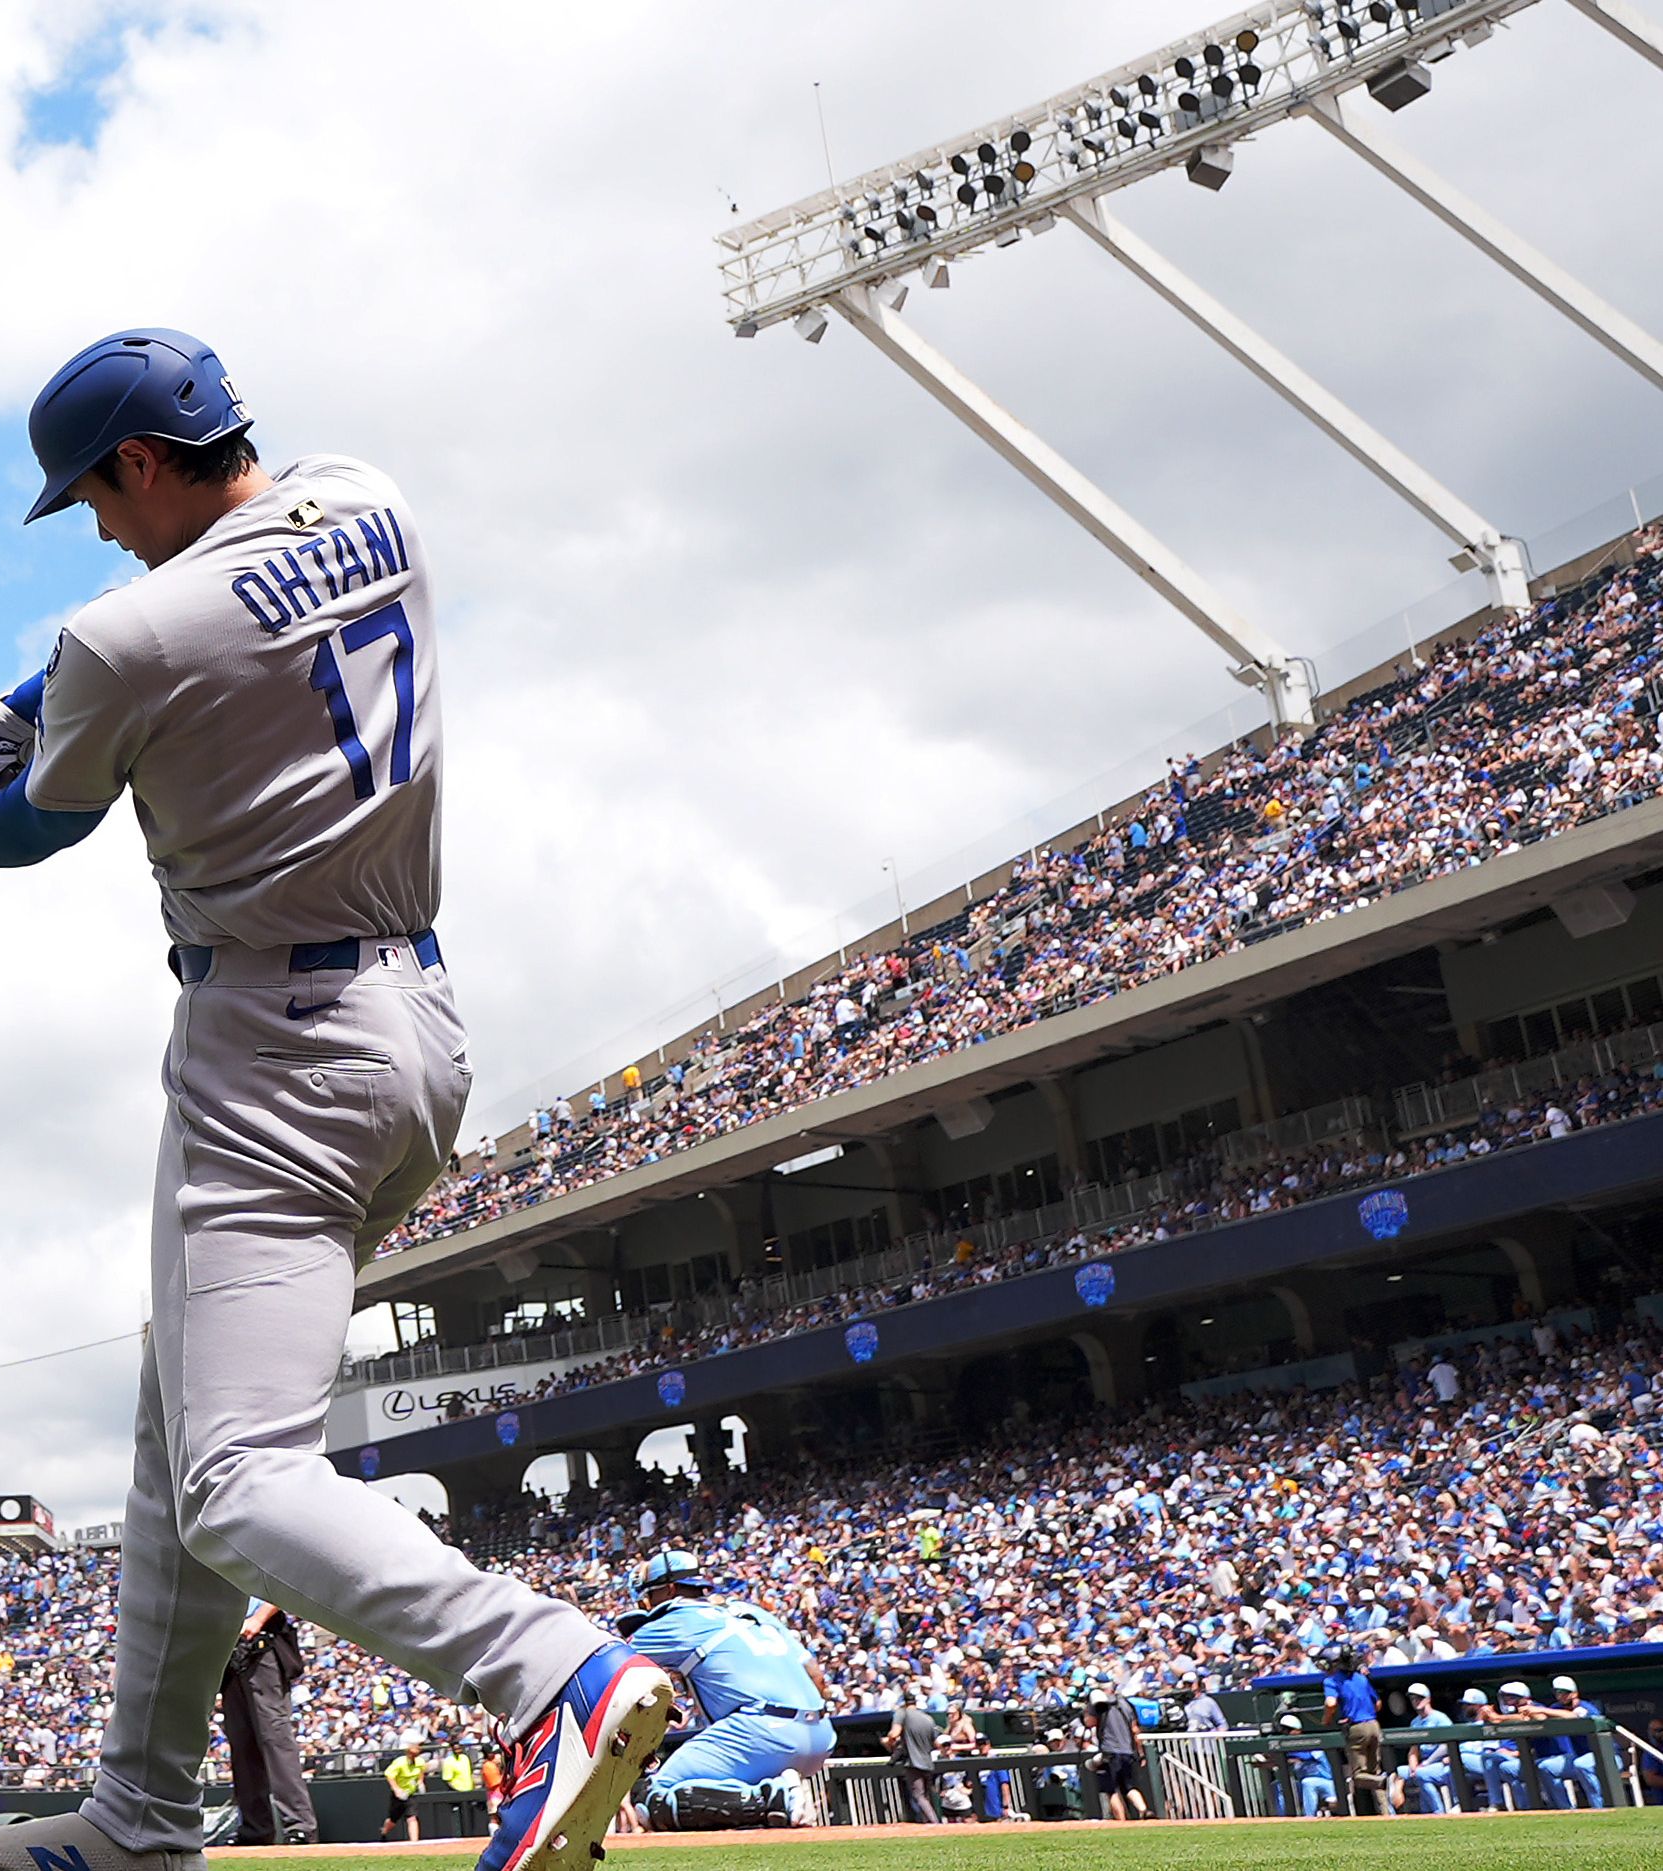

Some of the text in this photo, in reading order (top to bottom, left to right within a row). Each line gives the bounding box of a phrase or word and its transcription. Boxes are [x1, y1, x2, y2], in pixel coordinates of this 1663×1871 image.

[231, 508, 409, 634] OHTANI
[309, 600, 414, 800] 17
[418, 1383, 516, 1410] LEXUS
